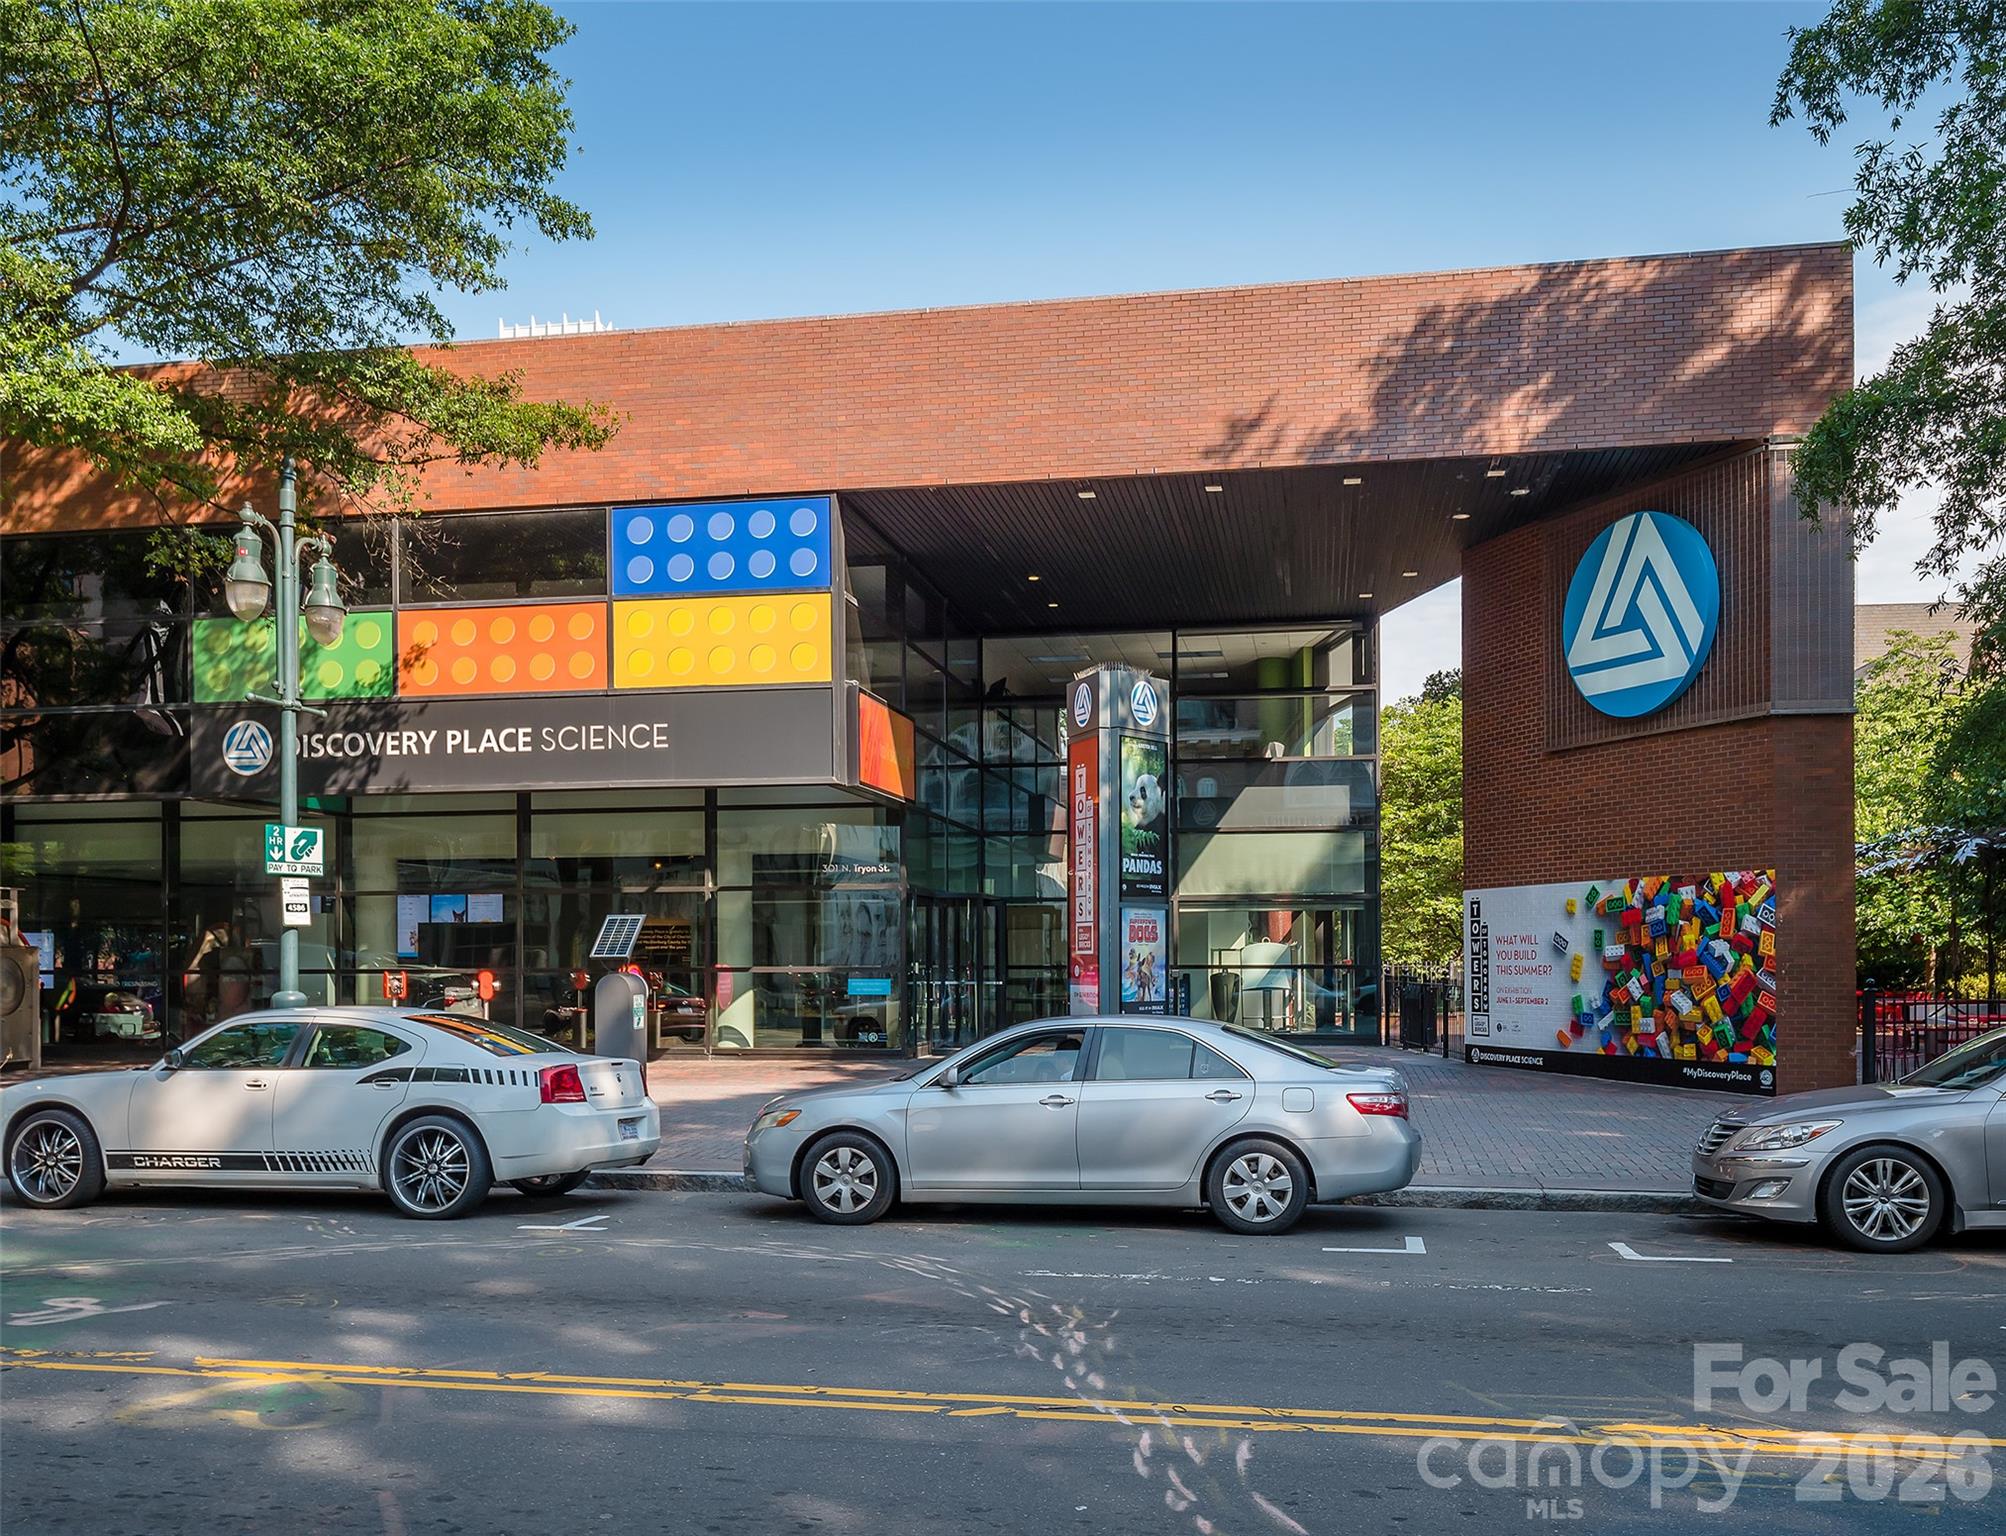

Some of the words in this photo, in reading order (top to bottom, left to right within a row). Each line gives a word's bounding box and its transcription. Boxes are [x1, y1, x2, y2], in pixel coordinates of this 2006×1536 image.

[446, 727, 532, 755] PLACE
[540, 722, 669, 752] SCIENCE
[272, 826, 281, 837] 2
[269, 836, 283, 846] HR
[1077, 774, 1086, 916] TOWERS
[268, 863, 283, 872] PAY
[287, 864, 298, 873] TO
[300, 865, 322, 874] PARK
[822, 863, 838, 873] 301
[841, 864, 851, 873] N.
[853, 864, 877, 875] Tryon
[878, 863, 891, 873] St.
[1122, 857, 1162, 874] PANDAS
[1495, 936, 1517, 945] WHAT
[1519, 935, 1538, 945] WILL
[1472, 904, 1481, 1009] TOWERS
[1496, 950, 1512, 960] YOU
[1514, 950, 1537, 960] BUILD
[1496, 964, 1512, 975] THIS
[1513, 964, 1552, 975] SUMMER?
[1480, 1052, 1505, 1061] DISCOVERY
[1505, 1055, 1520, 1063] PLACE
[1521, 1056, 1543, 1065] SCIENCE
[1682, 1066, 1752, 1081] #MyDiscoveryPlace
[133, 1156, 222, 1168] CHARGER
